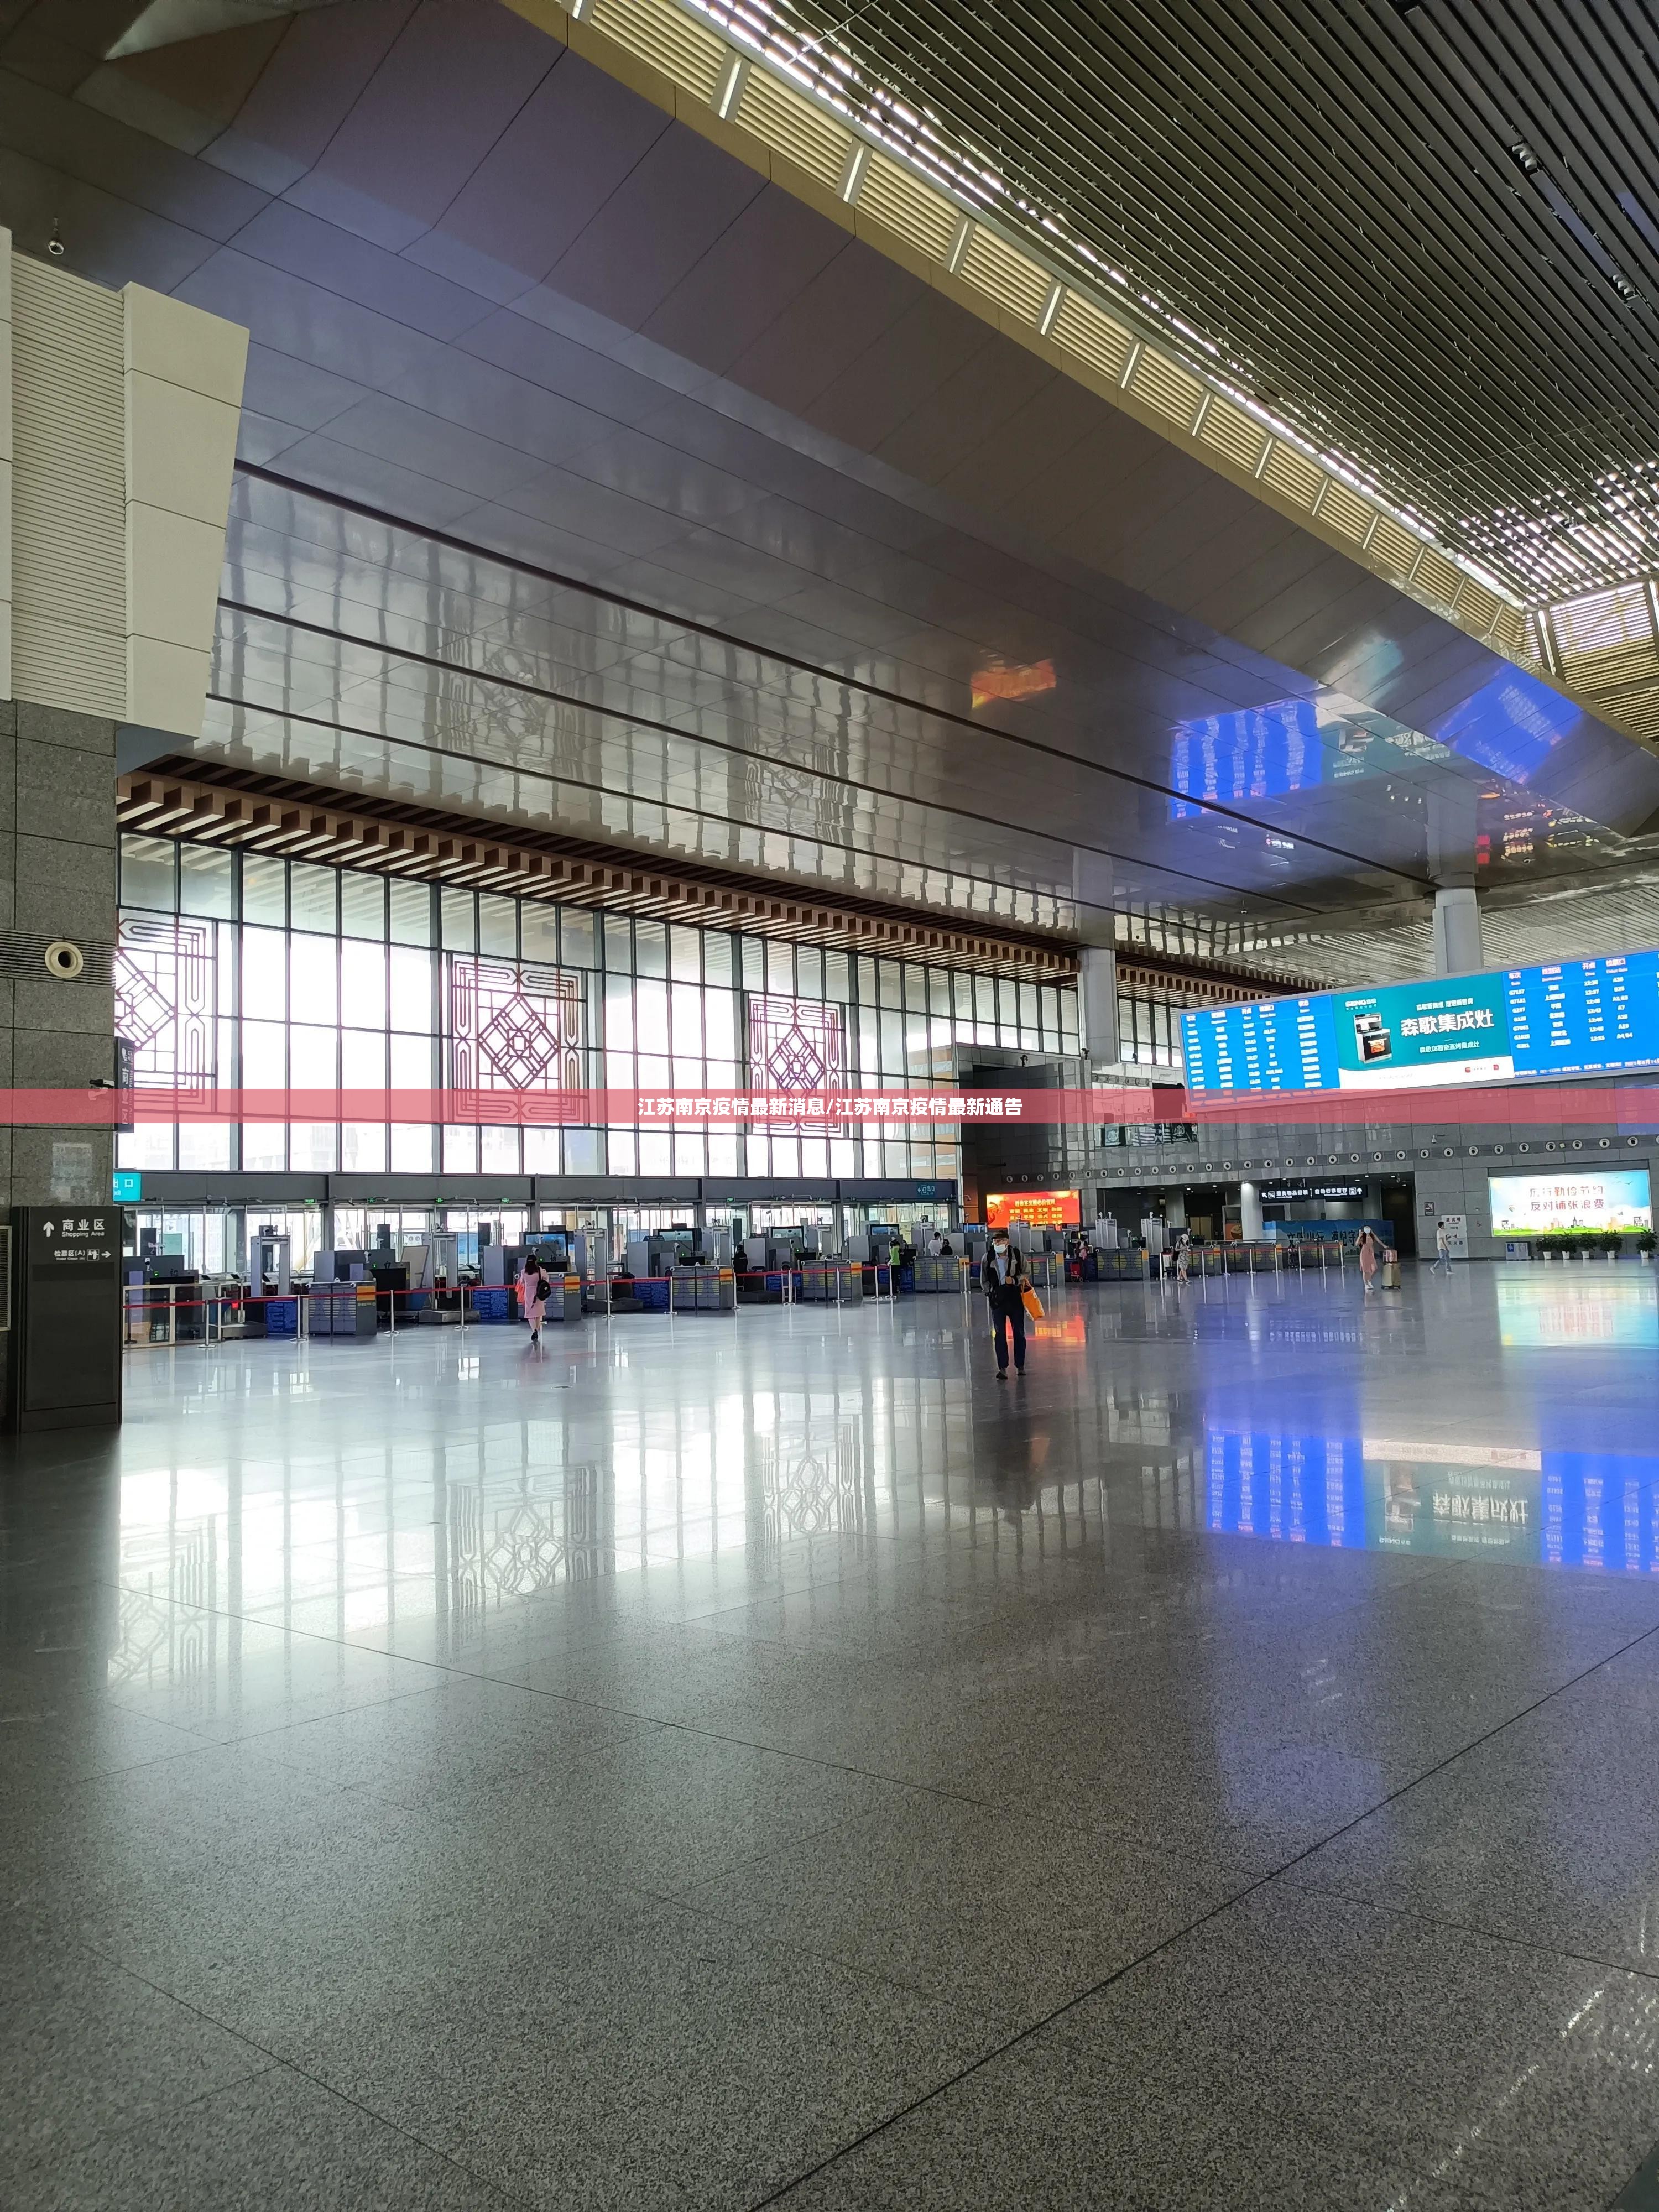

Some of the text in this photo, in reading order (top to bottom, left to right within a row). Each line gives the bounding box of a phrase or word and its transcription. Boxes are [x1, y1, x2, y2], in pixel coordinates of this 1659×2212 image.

[1400, 1008, 1495, 1037] 森歌集成灶
[1530, 1185, 1604, 1197] 厉行勤俭节约
[1531, 1199, 1605, 1211] 反对铺张浪费
[62, 1219, 105, 1232] 商业区
